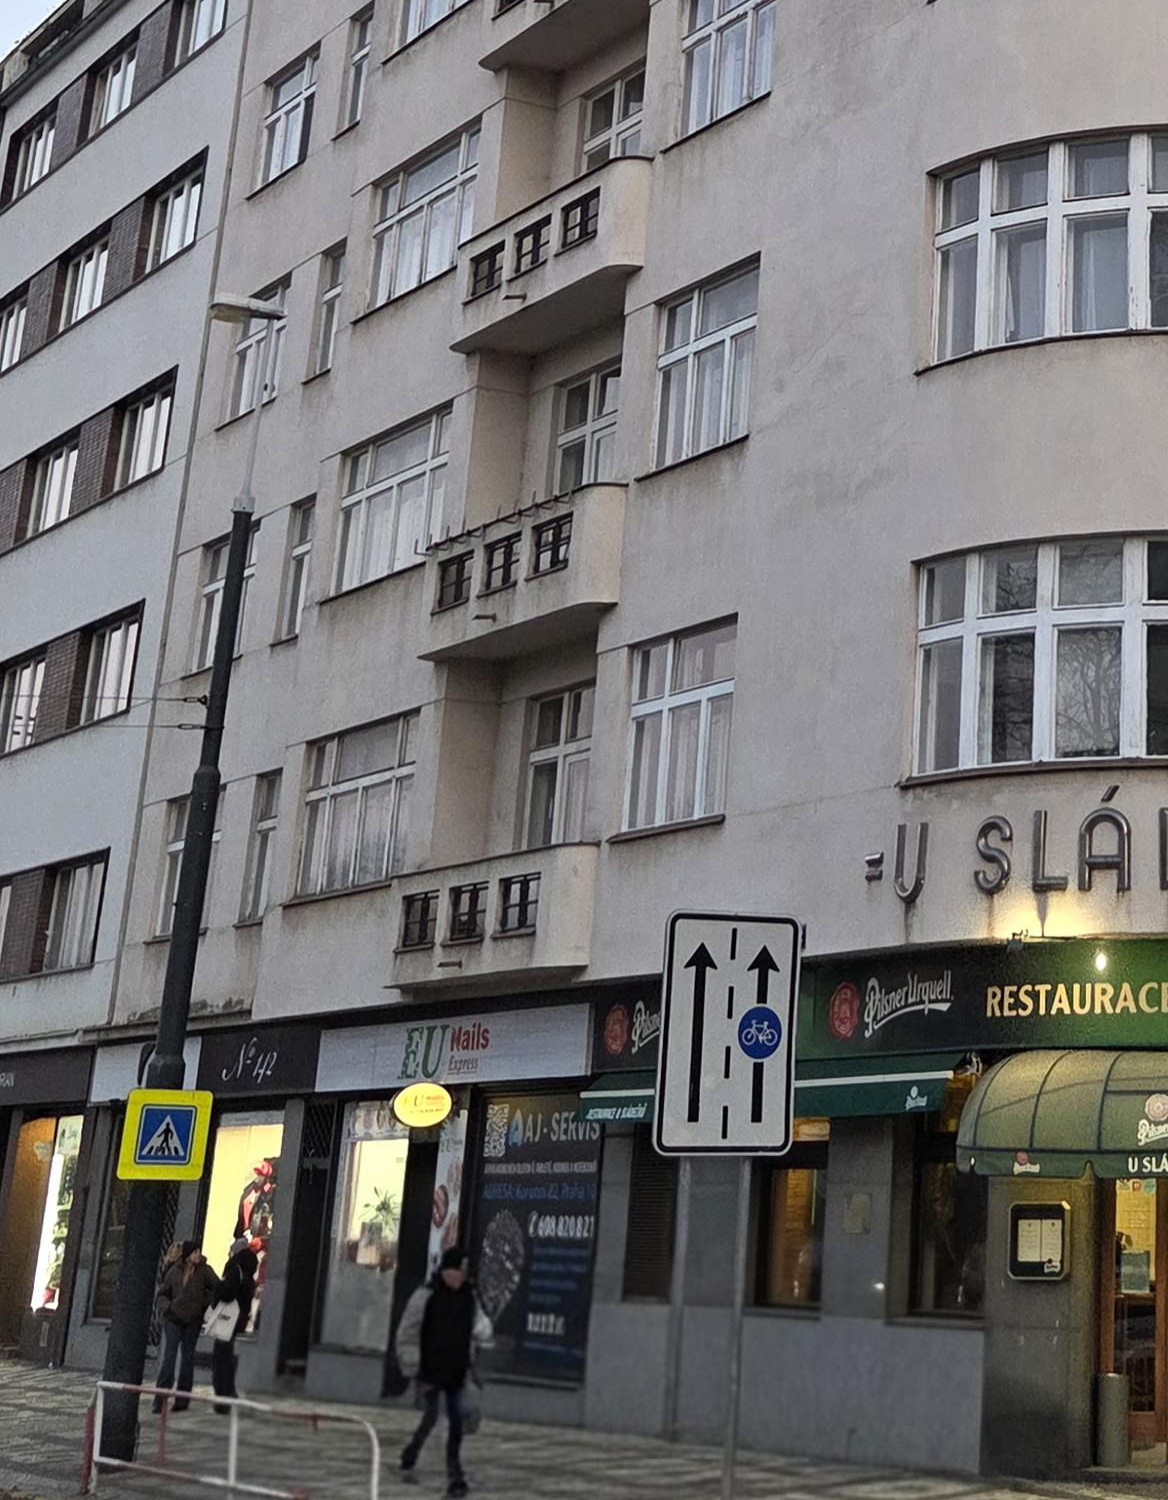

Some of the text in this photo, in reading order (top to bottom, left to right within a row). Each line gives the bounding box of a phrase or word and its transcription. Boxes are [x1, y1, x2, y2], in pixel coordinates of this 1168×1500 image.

[893, 821, 929, 900] U
[864, 970, 952, 1038] Pilsner Urquell
[397, 1022, 490, 1079] EU Nails
[448, 1055, 478, 1073] Express
[1128, 1157, 1139, 1173] U
